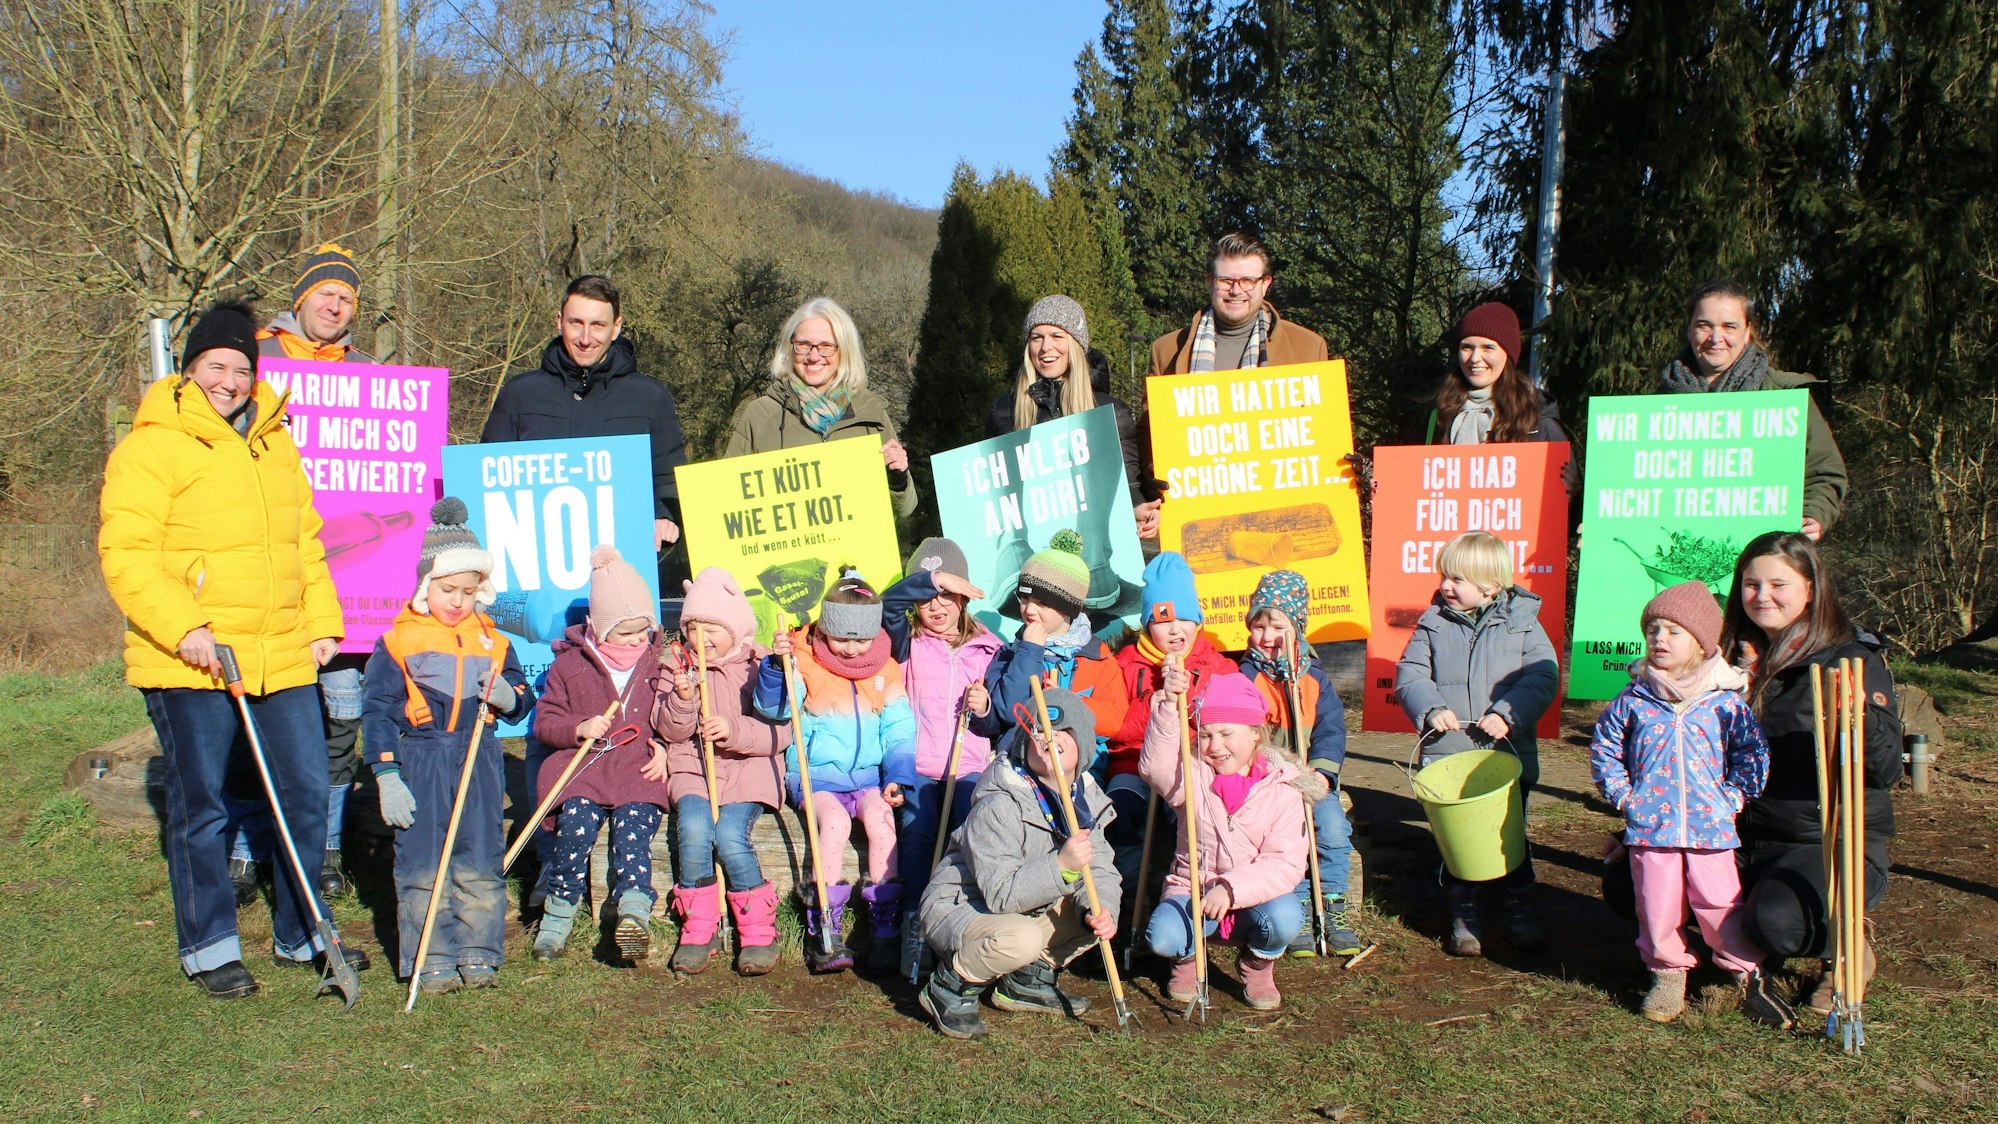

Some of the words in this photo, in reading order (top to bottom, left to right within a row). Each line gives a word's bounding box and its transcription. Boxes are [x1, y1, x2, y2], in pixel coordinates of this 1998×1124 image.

[264, 371, 361, 408] WARUM
[370, 377, 432, 412] HAST
[1229, 374, 1321, 413] HATTEN
[385, 419, 417, 453] SO
[1186, 421, 1250, 457] DOCH
[1648, 405, 1742, 441] KÖNNEN
[1752, 406, 1800, 438] UNS
[482, 449, 612, 488] COFFEE-TO
[1015, 428, 1090, 481] KLEB
[1469, 456, 1517, 489] HAB
[1633, 449, 1692, 479] DOCH
[740, 470, 765, 500] ET
[773, 458, 822, 494] KÜTT
[1167, 457, 1262, 499] SCHÖNE
[772, 502, 797, 532] ET
[805, 494, 853, 527] KOT.
[984, 492, 1023, 538] AN
[1416, 492, 1458, 532] FÜR
[1673, 485, 1789, 518] TRENNEN!
[741, 543, 760, 556] Und
[763, 541, 788, 552] wenn
[791, 536, 801, 547] et
[358, 597, 370, 609] DU
[361, 614, 394, 625] Glascon
[1585, 641, 1612, 655] LASS
[1376, 677, 1393, 689] UND
